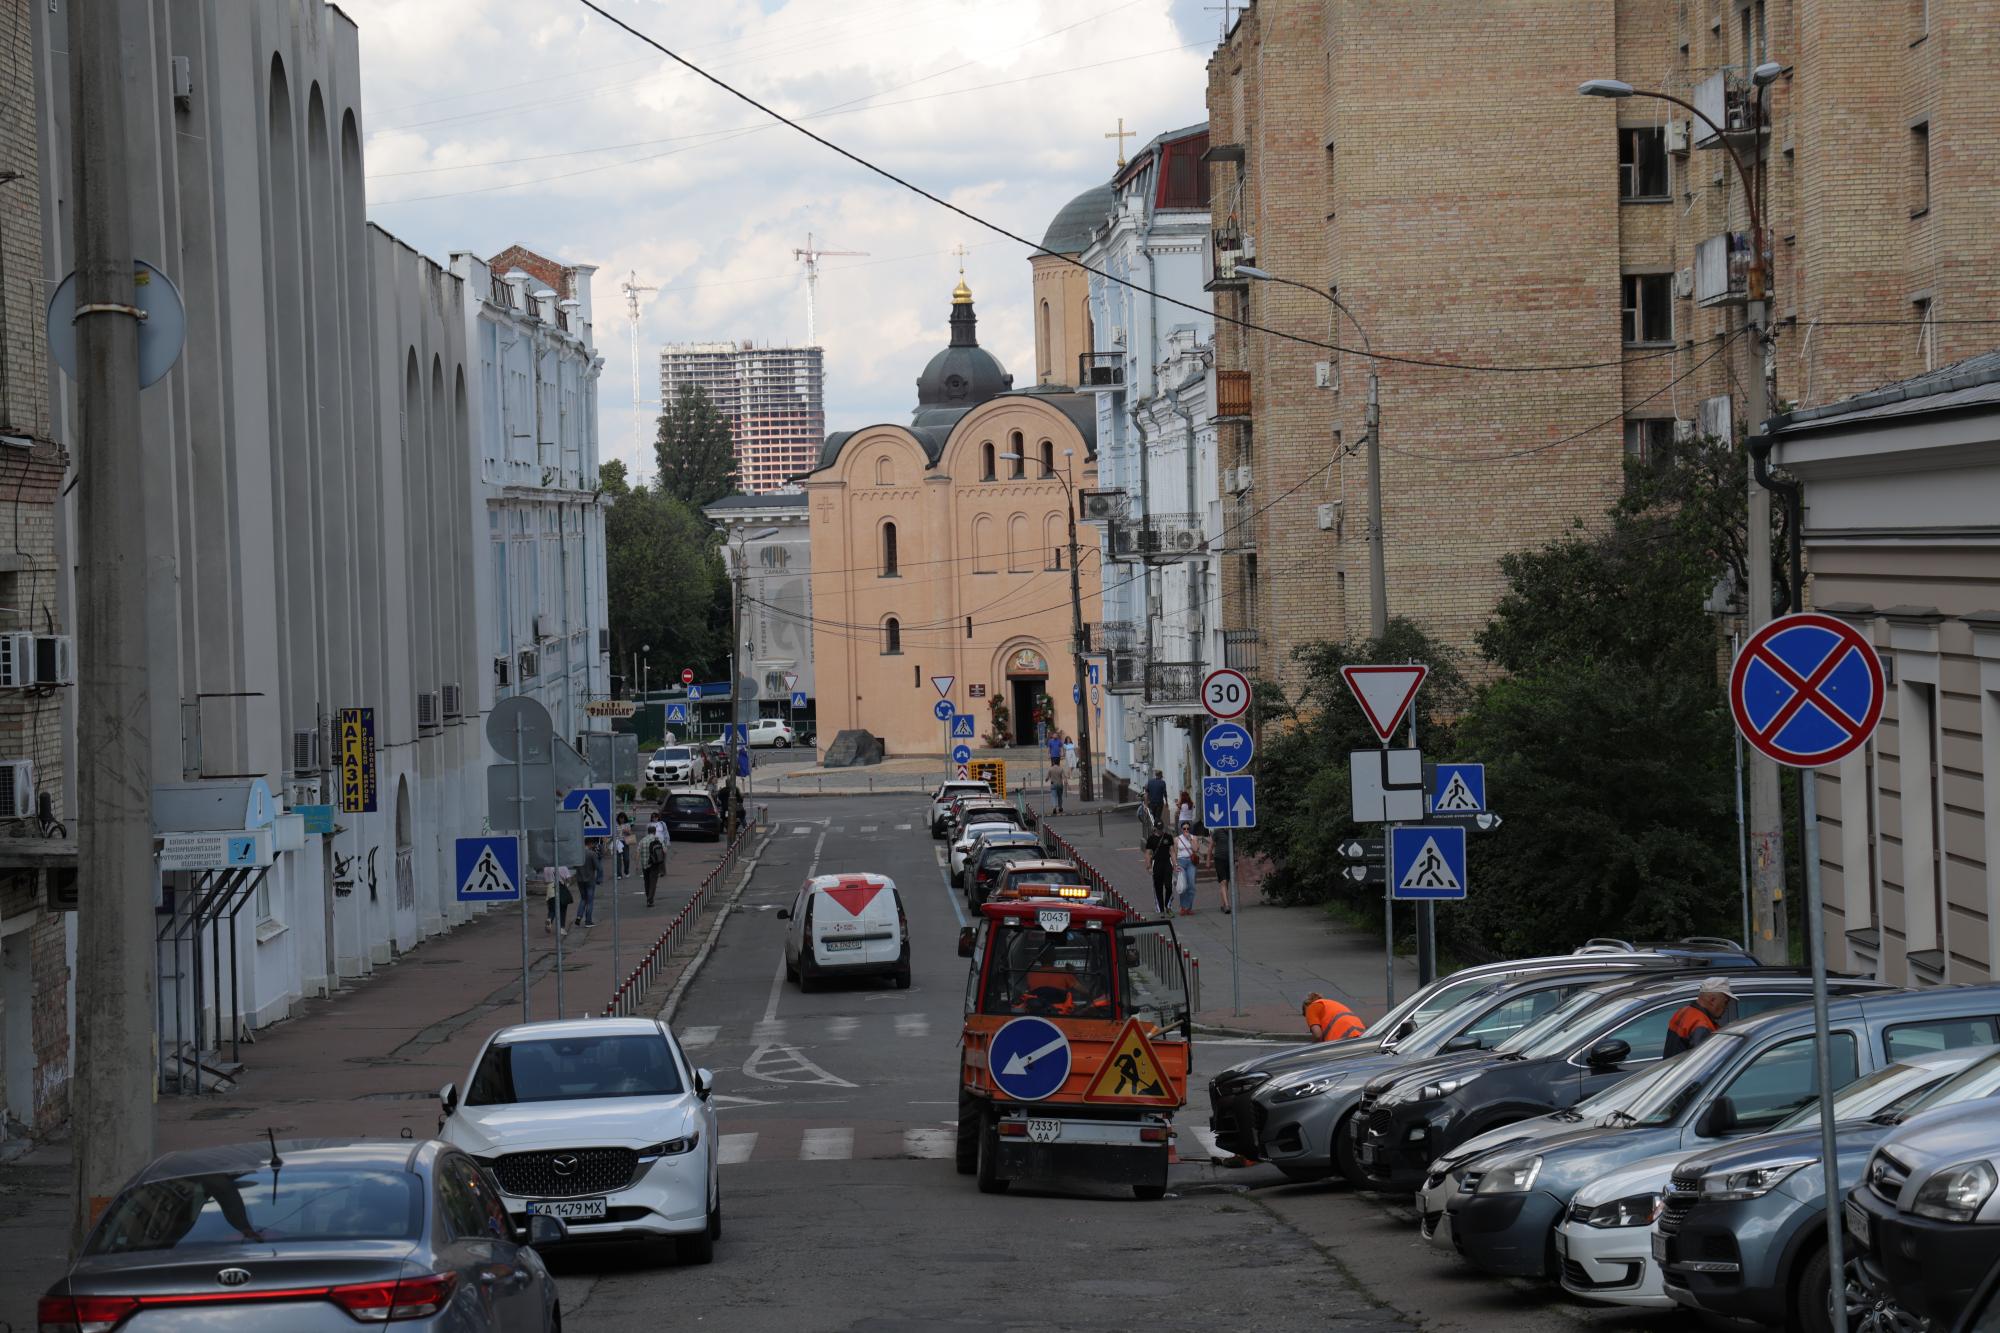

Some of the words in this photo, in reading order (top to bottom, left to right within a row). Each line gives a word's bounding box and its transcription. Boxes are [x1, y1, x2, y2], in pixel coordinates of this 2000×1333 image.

[1211, 684, 1240, 704] 30
[343, 710, 359, 810] МАГАЗИН
[1041, 912, 1069, 922] 20431
[1029, 1120, 1059, 1132] 73331
[1036, 1133, 1050, 1141] AA
[535, 1204, 553, 1215] KA
[555, 1203, 582, 1216] 1479
[584, 1202, 602, 1214] MX
[221, 1271, 245, 1283] KIA
